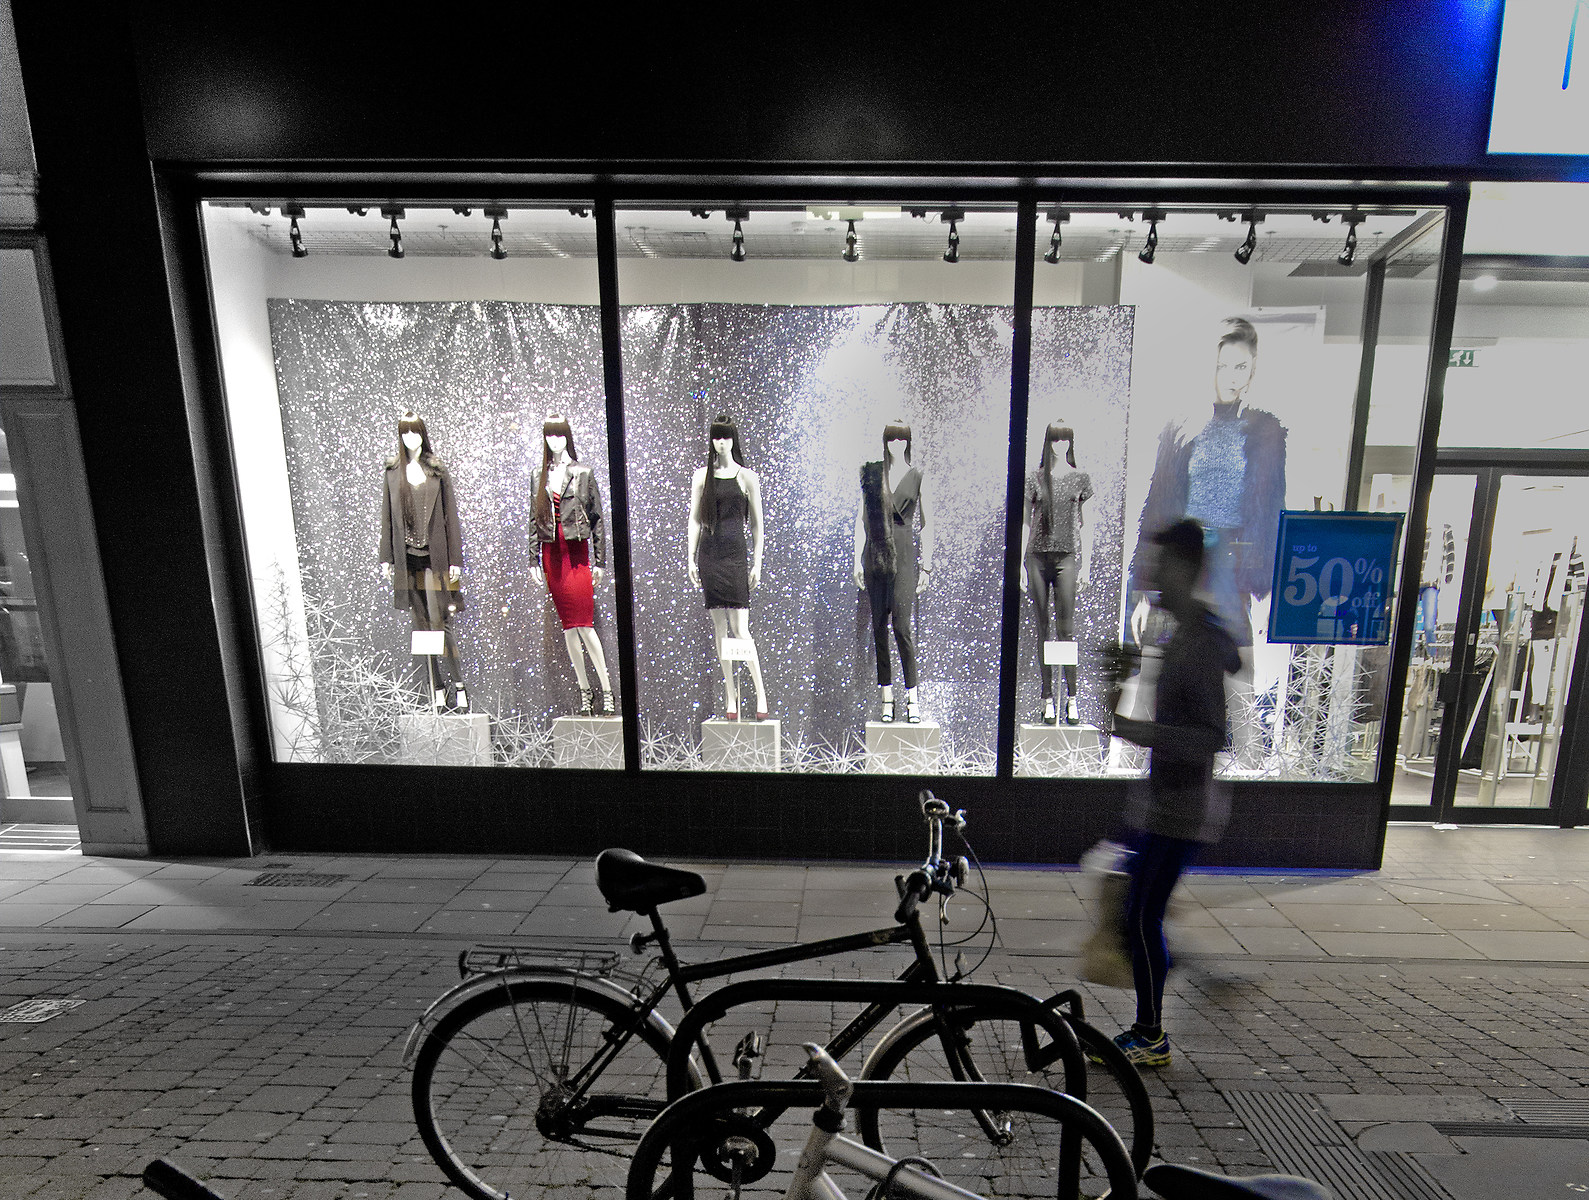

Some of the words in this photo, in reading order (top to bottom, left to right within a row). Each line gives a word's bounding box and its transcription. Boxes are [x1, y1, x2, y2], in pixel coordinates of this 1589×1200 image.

[1292, 544, 1305, 552] up
[1307, 543, 1318, 552] to
[1351, 591, 1381, 608] off
